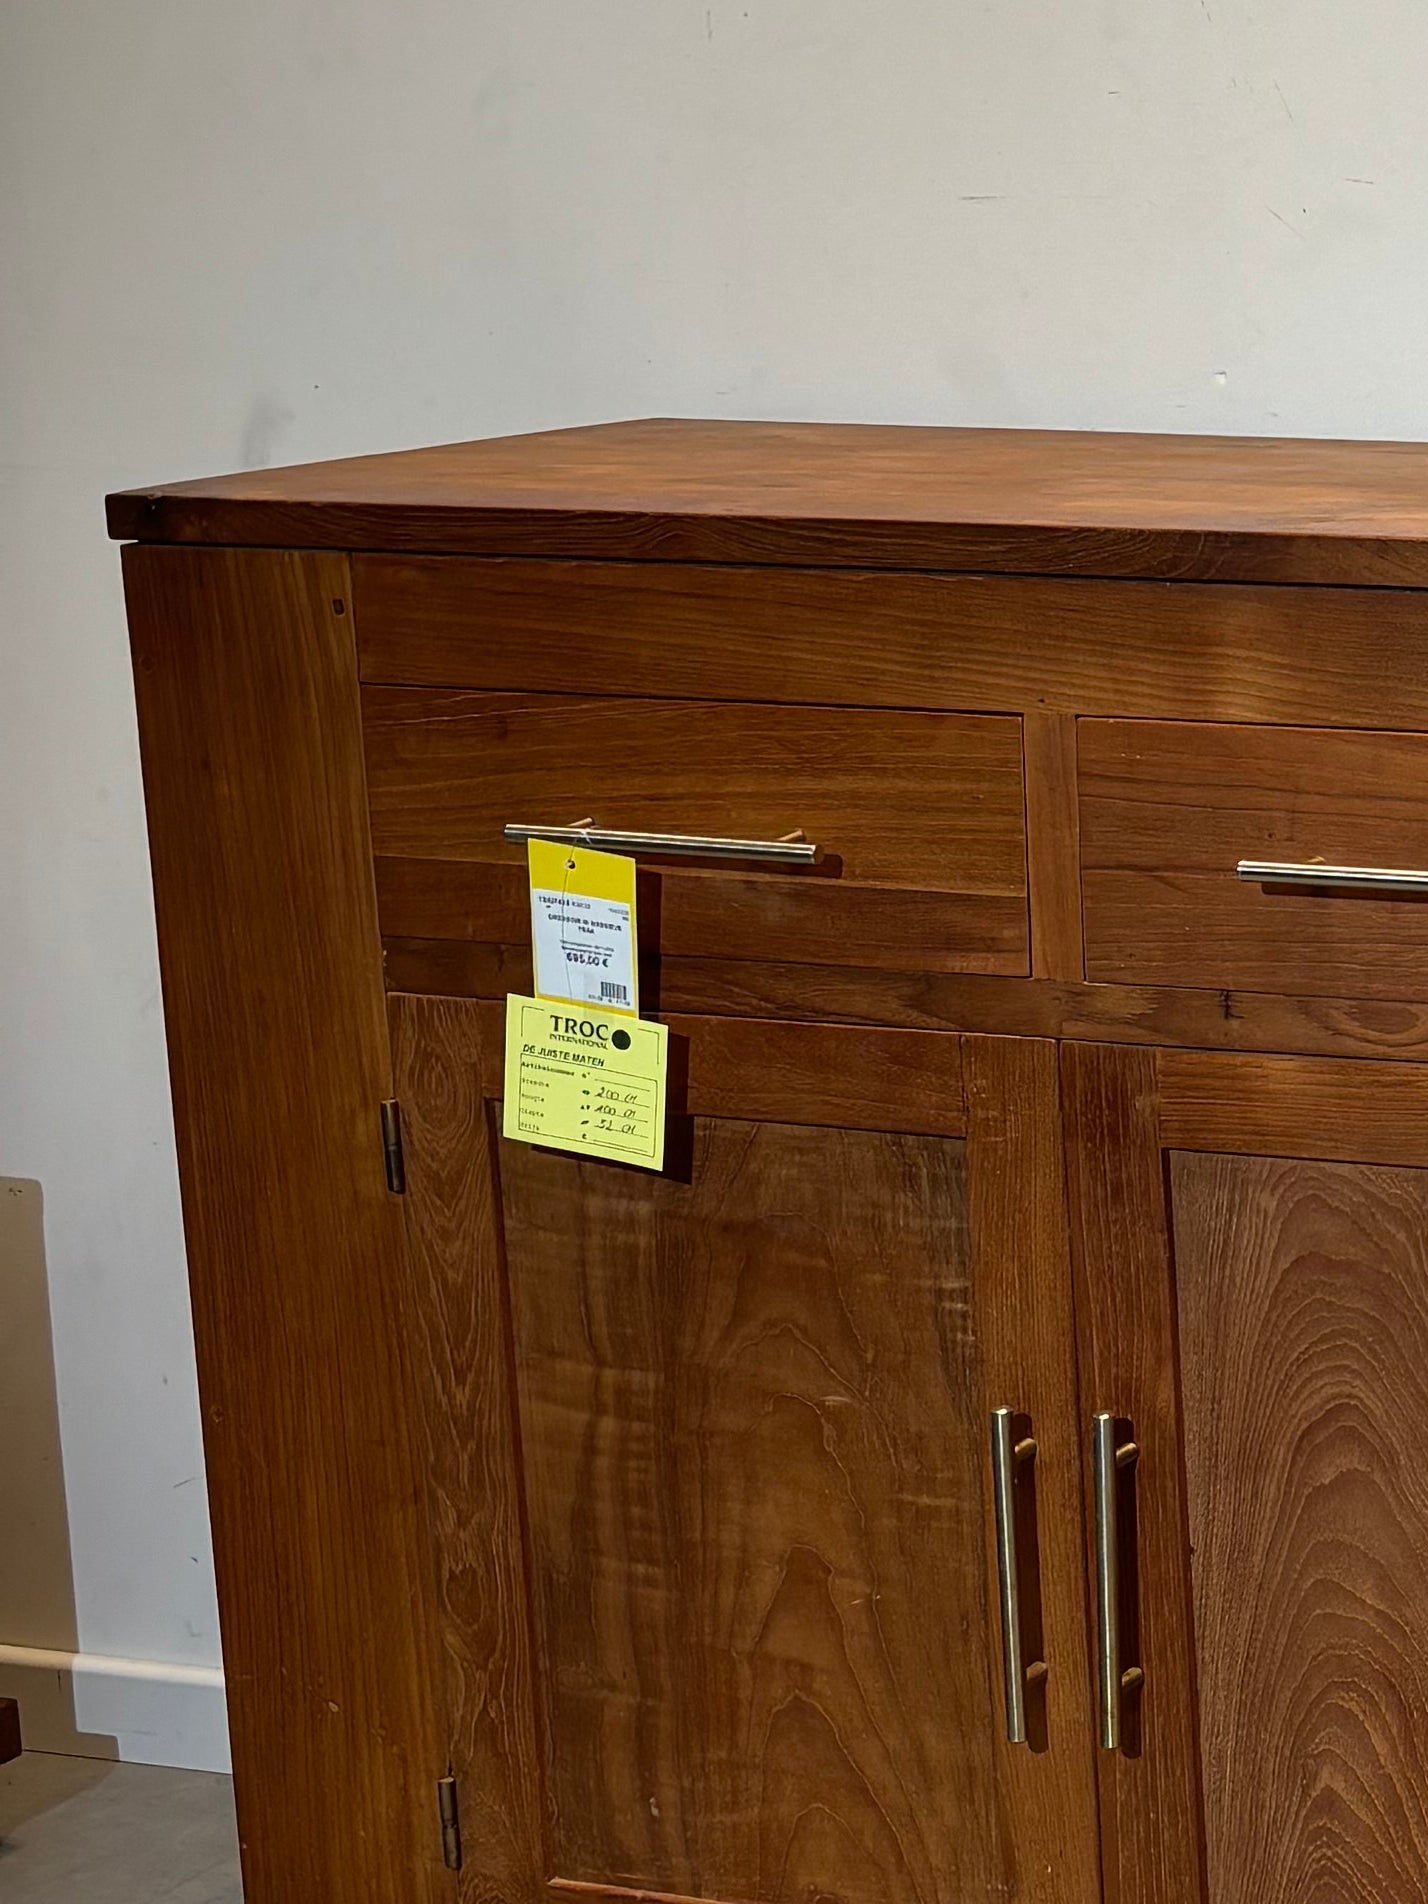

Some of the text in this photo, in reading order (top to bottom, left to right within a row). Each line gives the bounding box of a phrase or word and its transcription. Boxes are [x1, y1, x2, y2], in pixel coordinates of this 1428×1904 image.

[550, 1015, 609, 1041] TROC
[549, 1033, 609, 1050] INTERNATIONAL
[523, 1044, 605, 1067] DE JUISTE MATEN
[595, 1086, 620, 1100] 200
[595, 1105, 616, 1116] 100
